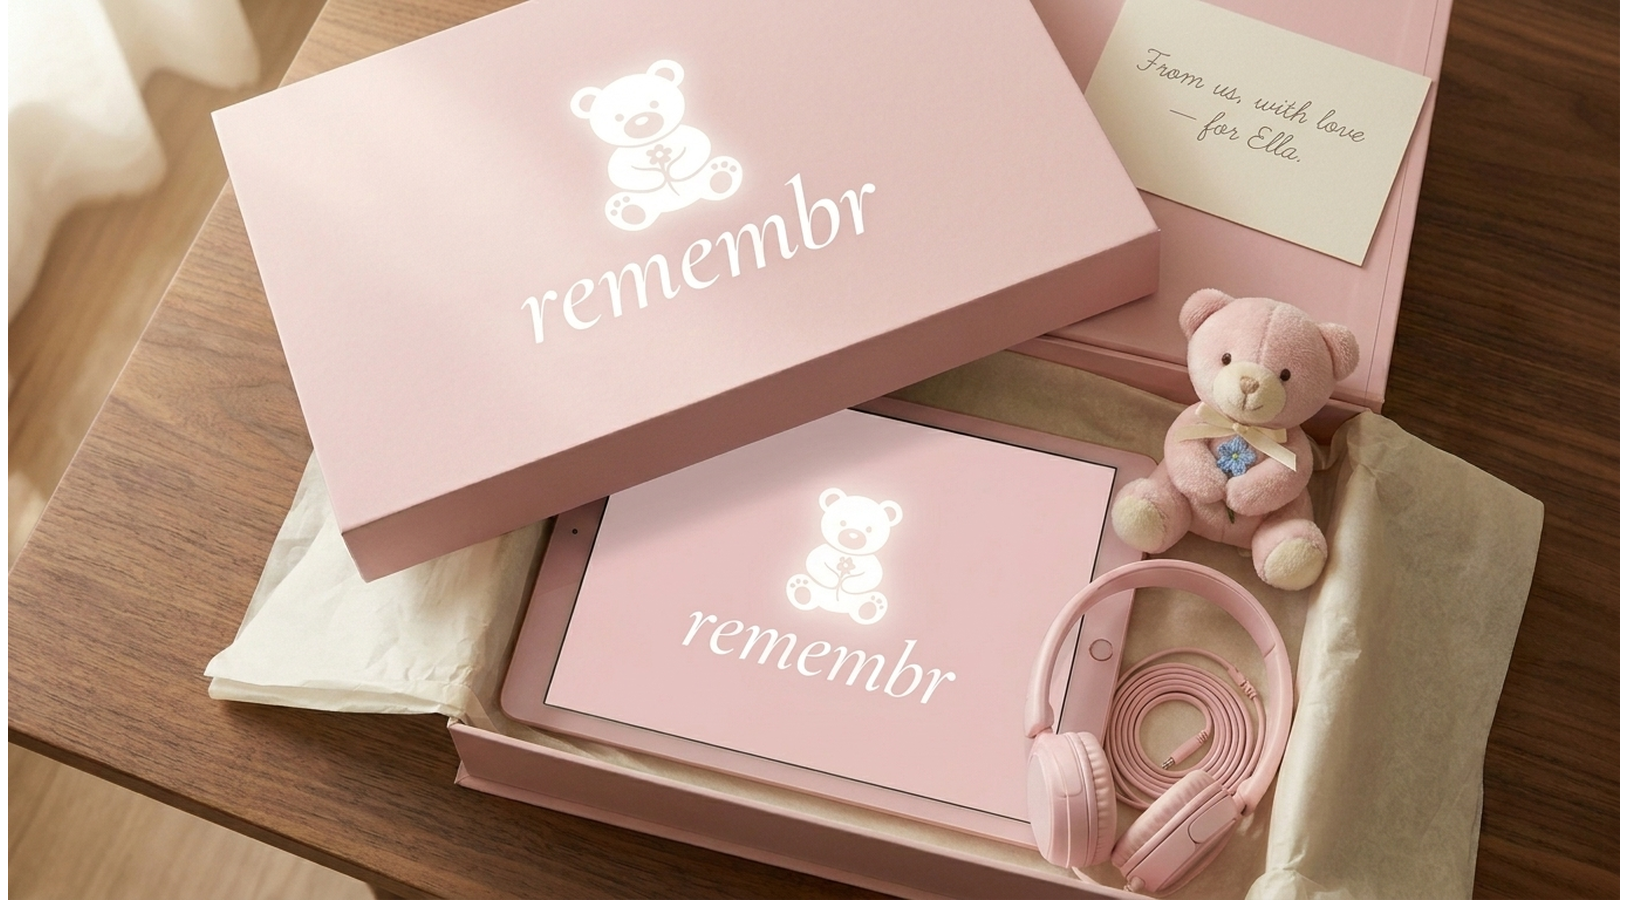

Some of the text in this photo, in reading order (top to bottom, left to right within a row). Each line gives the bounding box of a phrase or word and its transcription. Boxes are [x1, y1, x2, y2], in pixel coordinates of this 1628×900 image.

[1136, 48, 1366, 143] From us, with love
[1197, 111, 1240, 141] for
[1246, 125, 1301, 162] Ella.
[520, 173, 877, 344] remembr
[681, 610, 957, 705] remembr
